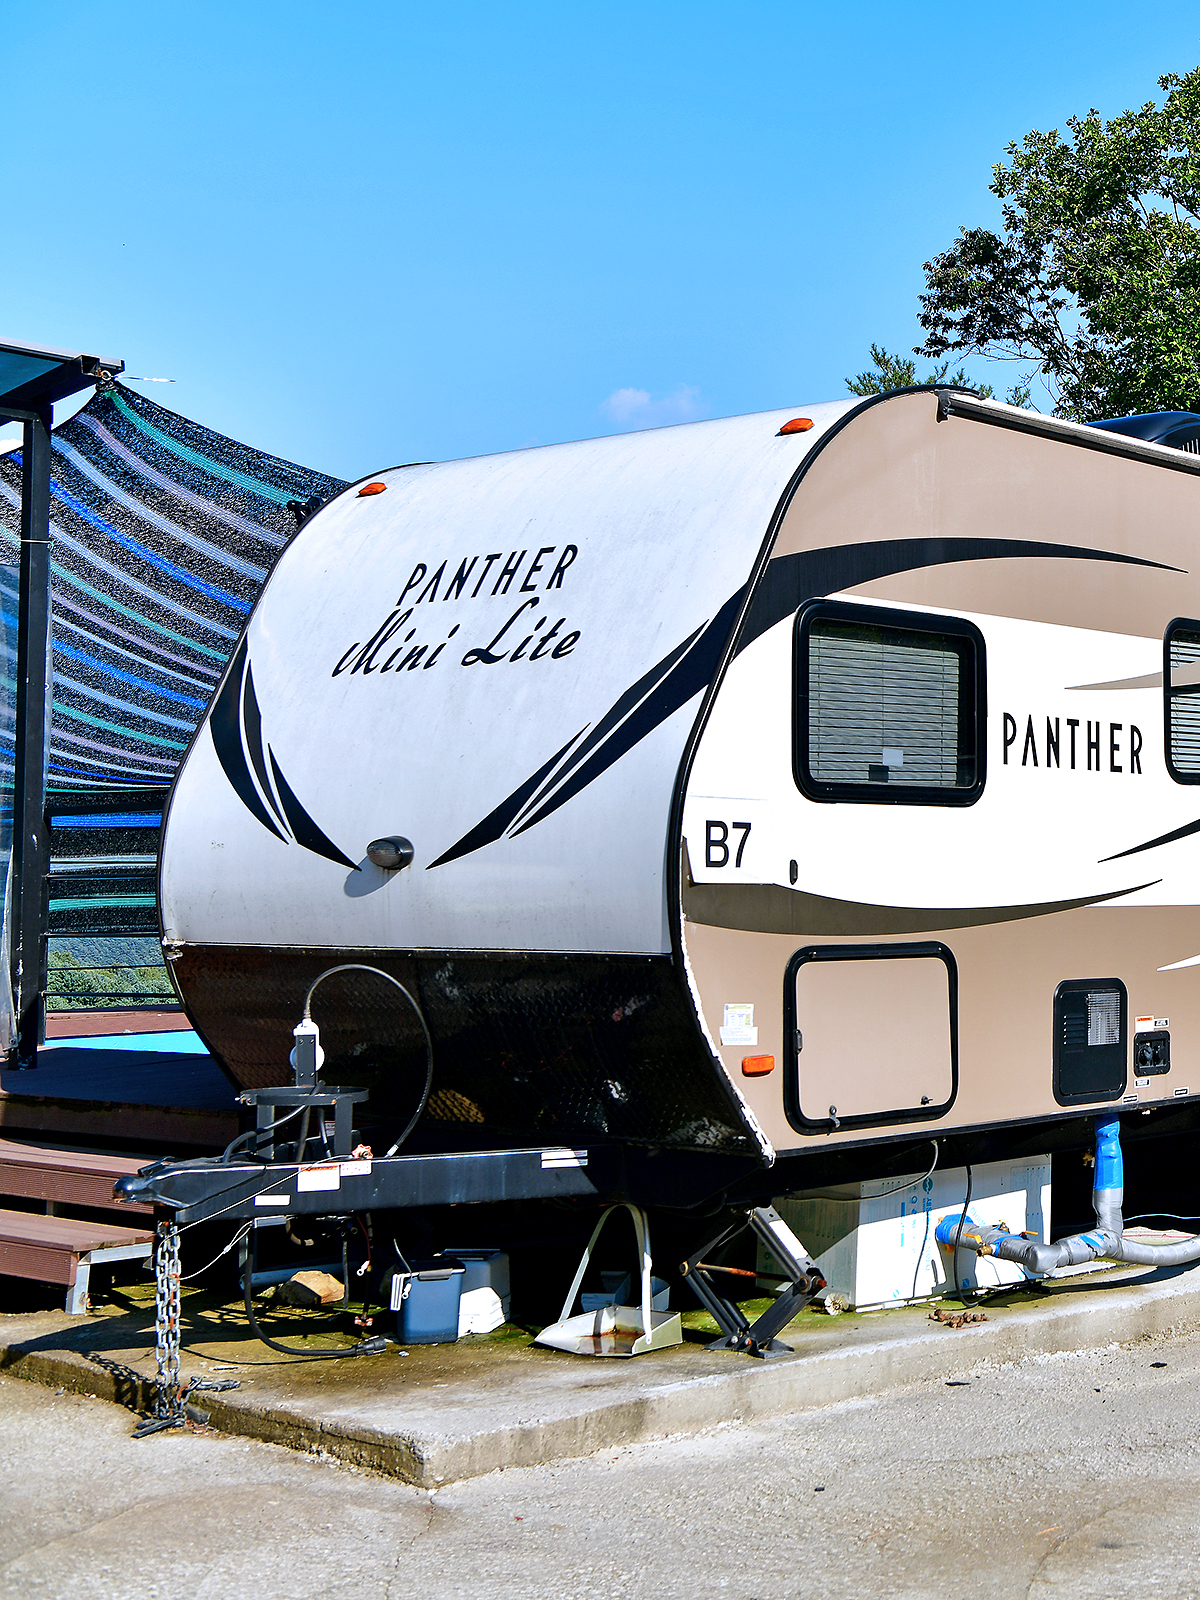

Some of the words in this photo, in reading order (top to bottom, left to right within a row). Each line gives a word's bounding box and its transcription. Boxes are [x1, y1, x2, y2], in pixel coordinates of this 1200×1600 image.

[395, 544, 578, 606] PANTHER
[332, 608, 460, 677] Mini
[461, 597, 581, 667] Lite
[1003, 712, 1143, 774] PANTHER
[706, 820, 751, 868] B7
